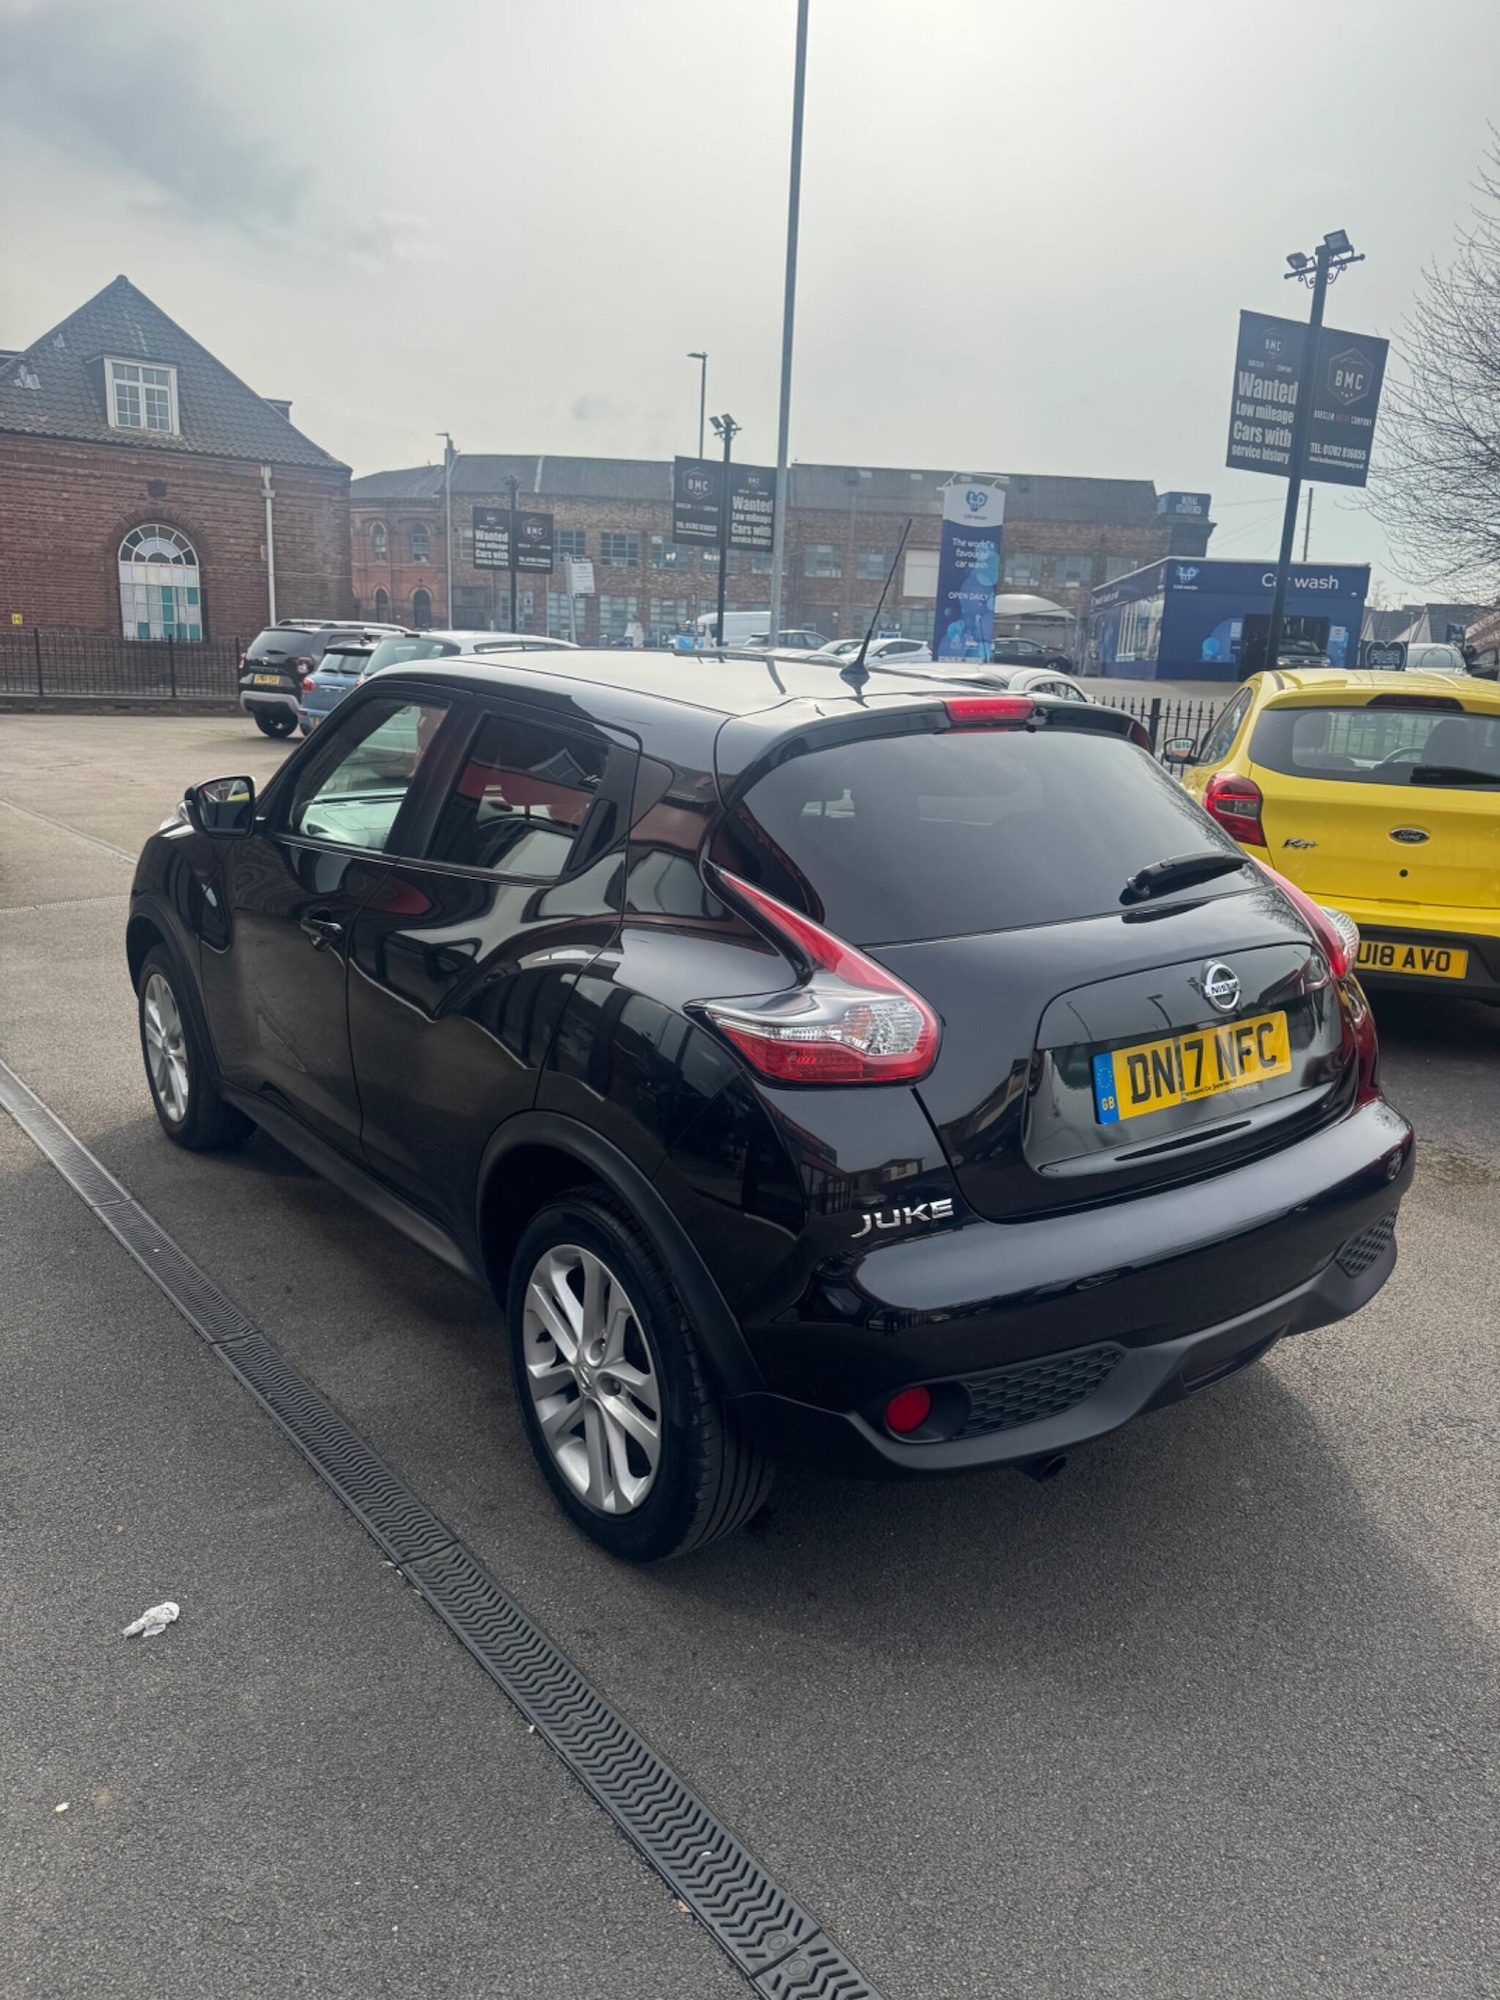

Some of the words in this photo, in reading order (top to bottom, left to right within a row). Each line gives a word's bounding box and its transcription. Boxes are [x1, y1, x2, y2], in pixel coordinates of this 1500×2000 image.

[1239, 371, 1299, 405] Wanted
[1334, 369, 1363, 390] BMC
[1236, 400, 1256, 417] Low
[1255, 405, 1294, 425] mileage
[1233, 420, 1263, 443] Cars
[1264, 427, 1292, 448] with
[1231, 444, 1261, 459] service
[1262, 447, 1290, 465] history
[687, 479, 708, 491] BMC
[732, 495, 774, 513] Wanted
[474, 529, 509, 543] Wanted
[731, 522, 752, 535] Cars
[952, 537, 967, 547] The
[967, 539, 995, 550] world's
[955, 560, 967, 569] car
[968, 561, 988, 569] wash
[1294, 574, 1339, 590] wash
[948, 591, 969, 600] OPEN
[969, 592, 990, 601] DAILY
[1402, 946, 1452, 972] AVO
[1127, 1038, 1204, 1105] DN17
[1214, 1022, 1278, 1081] NFC
[1101, 1095, 1116, 1111] GB
[850, 1198, 955, 1238] JUKE
